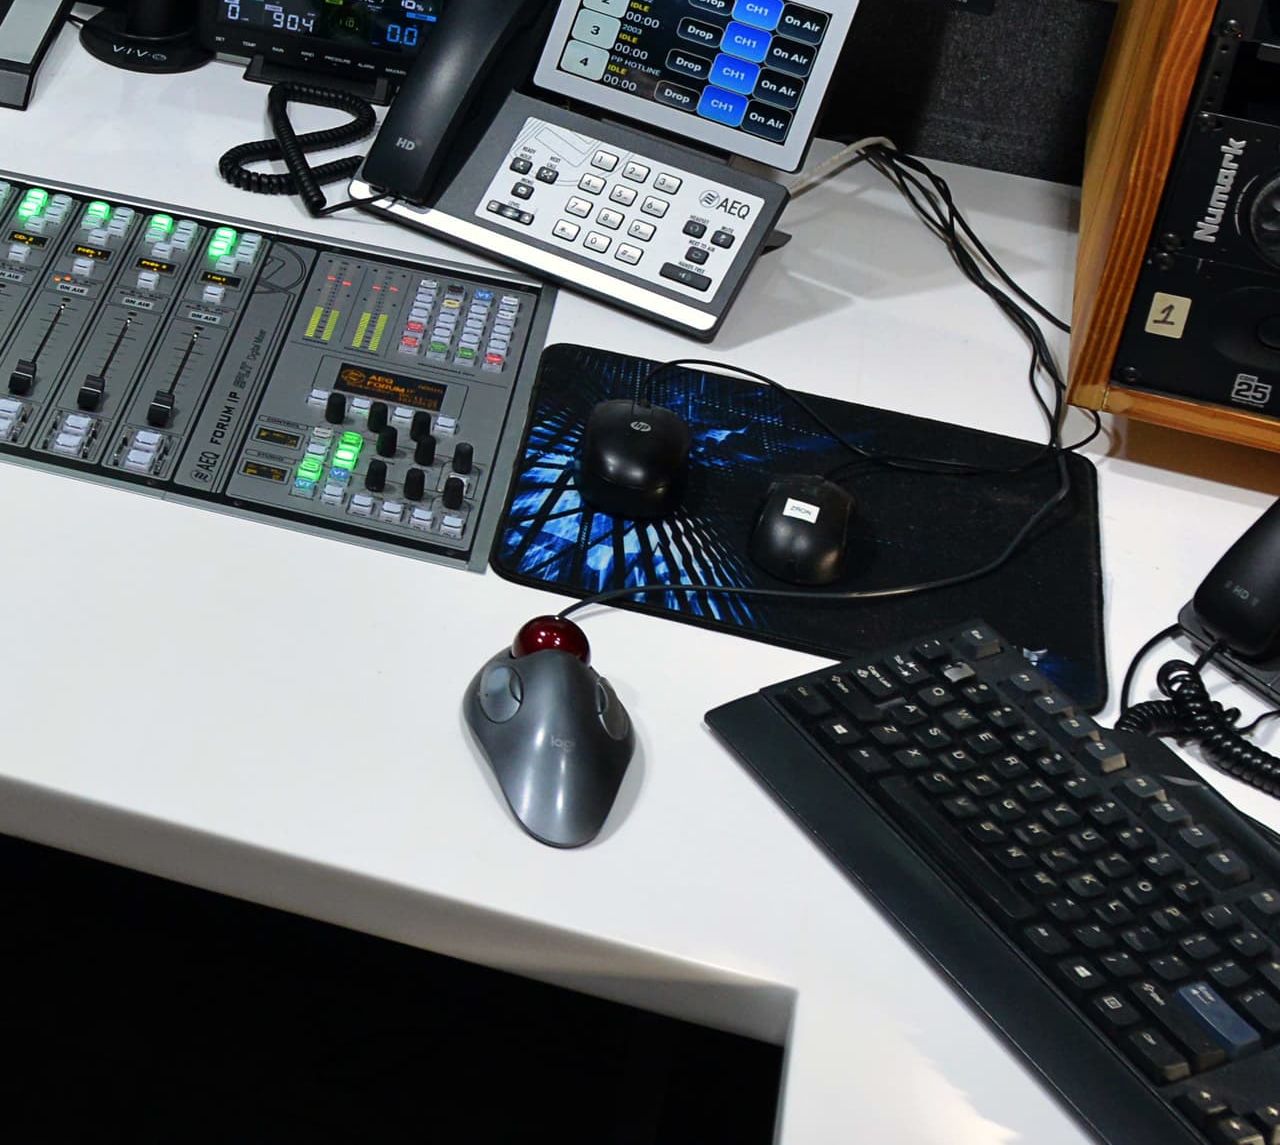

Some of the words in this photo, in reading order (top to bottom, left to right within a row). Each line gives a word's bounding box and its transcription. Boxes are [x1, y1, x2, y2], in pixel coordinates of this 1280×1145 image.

[630, 1, 650, 13] IDLE
[745, 3, 769, 17] CH1
[626, 11, 660, 29] 00:00
[784, 15, 801, 27] On
[801, 20, 821, 33] Air
[590, 25, 600, 36] 3
[619, 32, 638, 44] IDLE
[687, 25, 714, 41] Drop
[734, 34, 757, 49] CH1
[614, 42, 648, 60] 00:00
[773, 47, 789, 59] On
[790, 53, 809, 66] Air
[579, 56, 589, 67] 4
[607, 64, 627, 76] IDLE
[611, 55, 623, 65] PP
[625, 60, 662, 77] HOTLINE
[675, 56, 702, 73] Drop
[722, 66, 745, 81] CH1
[603, 74, 637, 92] 00:00
[761, 79, 777, 91] On
[778, 84, 797, 98] Air
[664, 88, 690, 105] Drop
[710, 99, 734, 113] CH1
[749, 112, 765, 123] On
[766, 116, 785, 130] Air
[396, 137, 416, 153] HD
[1193, 138, 1246, 243] Numark
[716, 197, 751, 221] AEQ
[1153, 304, 1174, 325] 1
[370, 373, 393, 385] AEQ
[1235, 380, 1269, 402] 25
[195, 449, 221, 473] AEQ
[210, 408, 236, 446] FORUM
